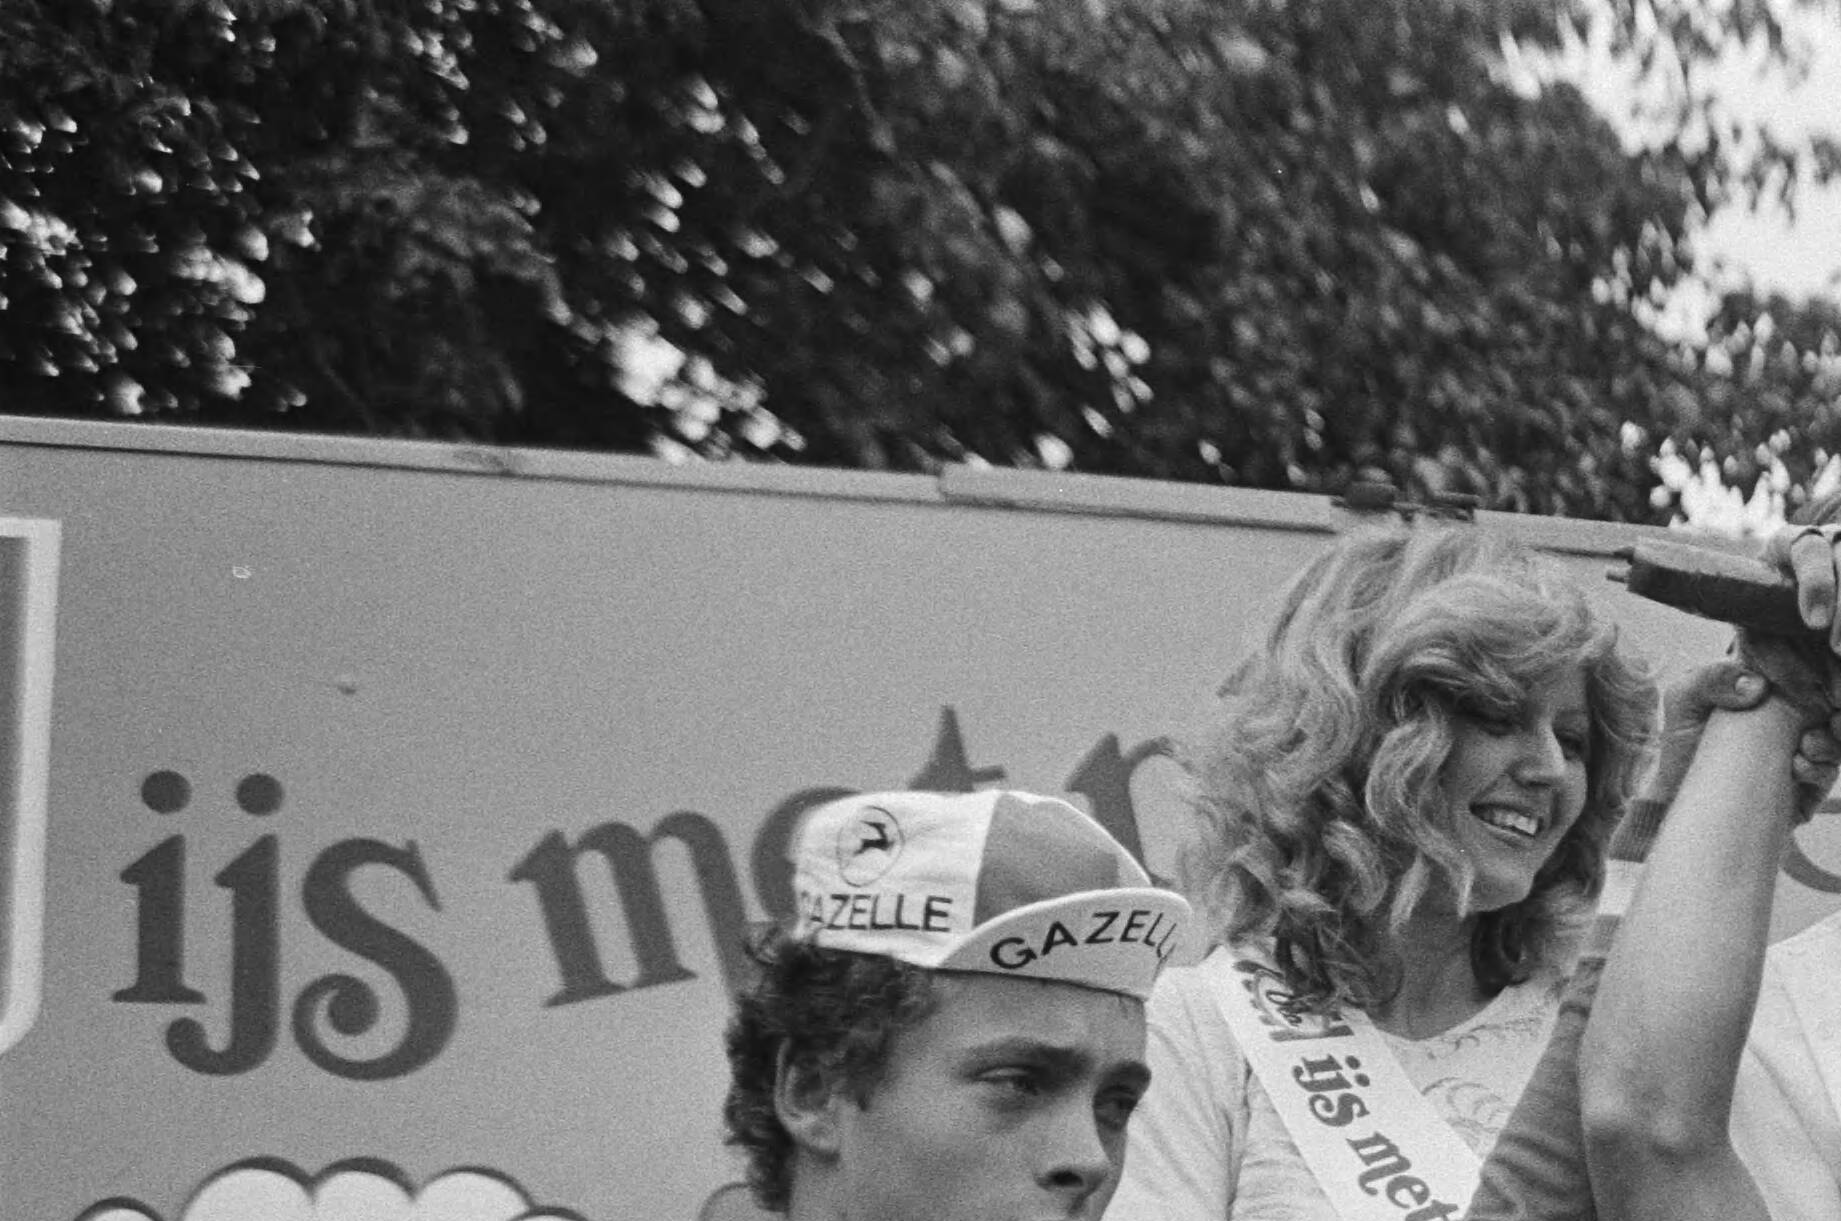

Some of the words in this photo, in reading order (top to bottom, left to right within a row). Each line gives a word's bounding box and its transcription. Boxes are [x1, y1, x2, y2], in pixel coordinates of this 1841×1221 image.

[112, 769, 460, 1082] ijs
[803, 892, 953, 933] AZELLE
[989, 909, 1178, 971] GAZELL
[1291, 1053, 1371, 1127] ijs
